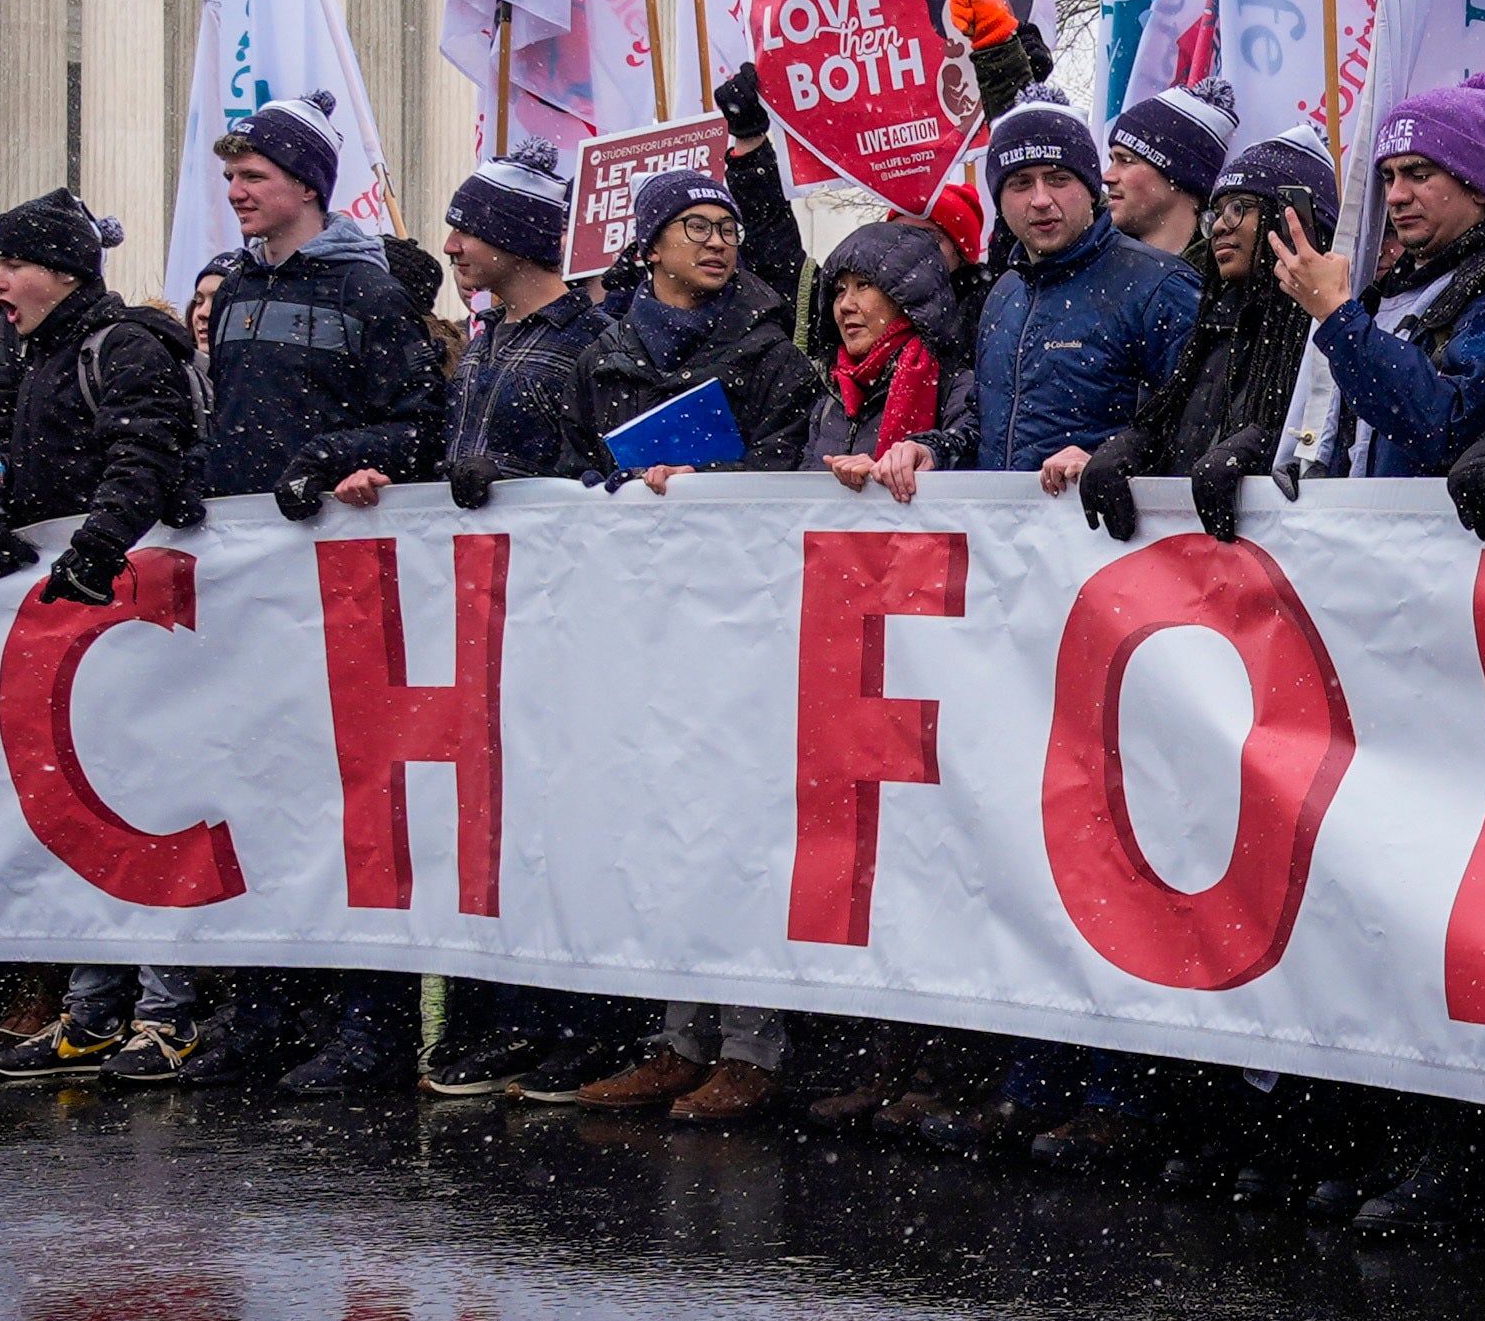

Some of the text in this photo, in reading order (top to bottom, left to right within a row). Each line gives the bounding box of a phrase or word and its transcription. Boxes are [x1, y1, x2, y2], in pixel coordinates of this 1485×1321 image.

[814, 16, 904, 59] them
[785, 37, 926, 112] BOTH
[595, 144, 711, 190] LET THEIR
[885, 158, 902, 169] LIFE
[902, 156, 911, 165] to
[1025, 145, 1063, 160] PRO-LIFE
